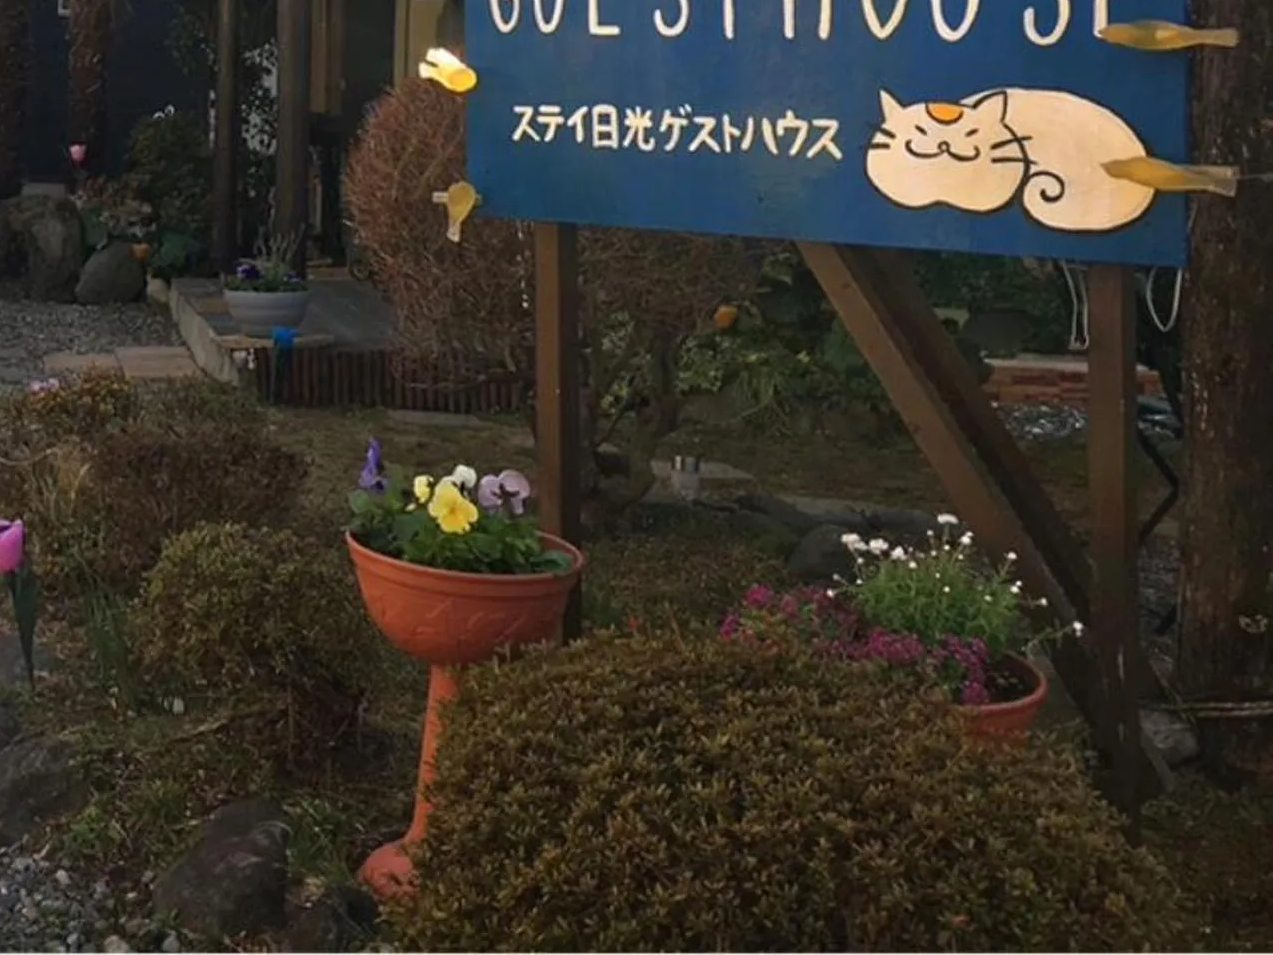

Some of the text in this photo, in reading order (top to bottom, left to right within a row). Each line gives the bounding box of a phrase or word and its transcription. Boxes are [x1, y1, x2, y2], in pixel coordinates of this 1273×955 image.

[512, 104, 842, 161] ステイ日光ゲストハウス
